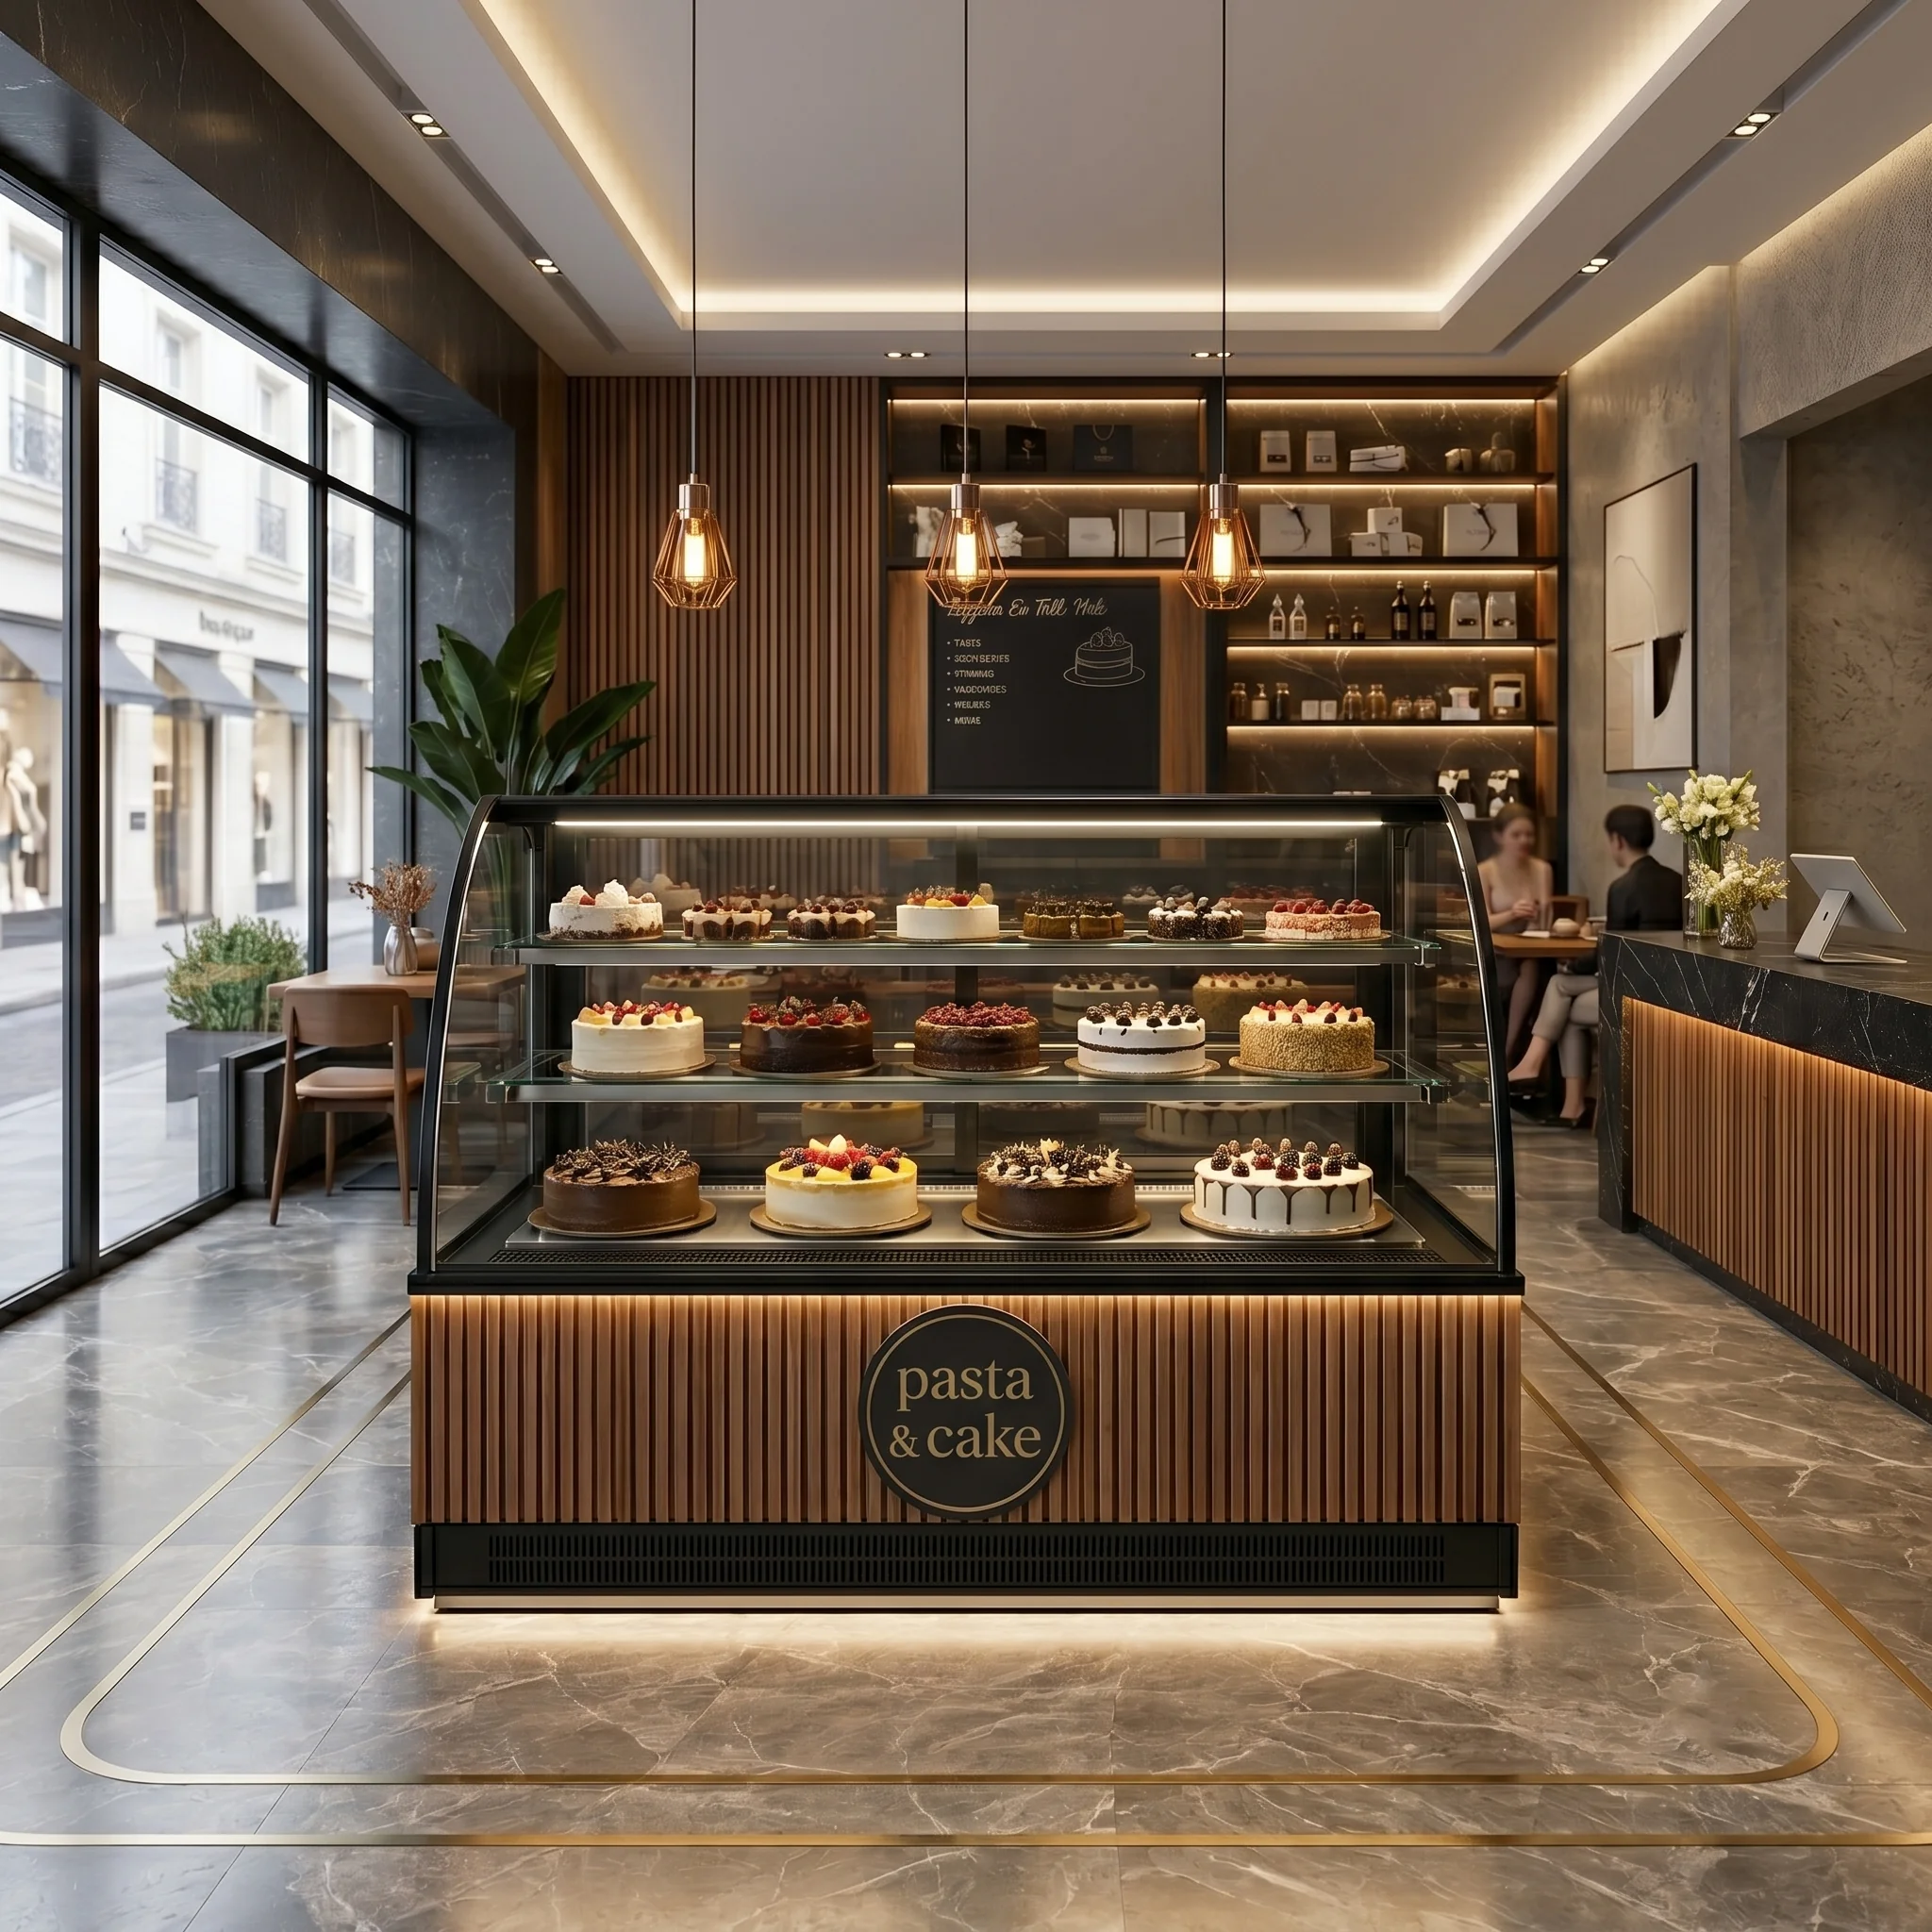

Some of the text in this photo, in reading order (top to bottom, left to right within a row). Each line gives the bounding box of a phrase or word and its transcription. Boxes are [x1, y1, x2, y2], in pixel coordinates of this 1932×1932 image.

[896, 1359, 1034, 1411] pasta
[889, 1412, 1041, 1458] & cake
